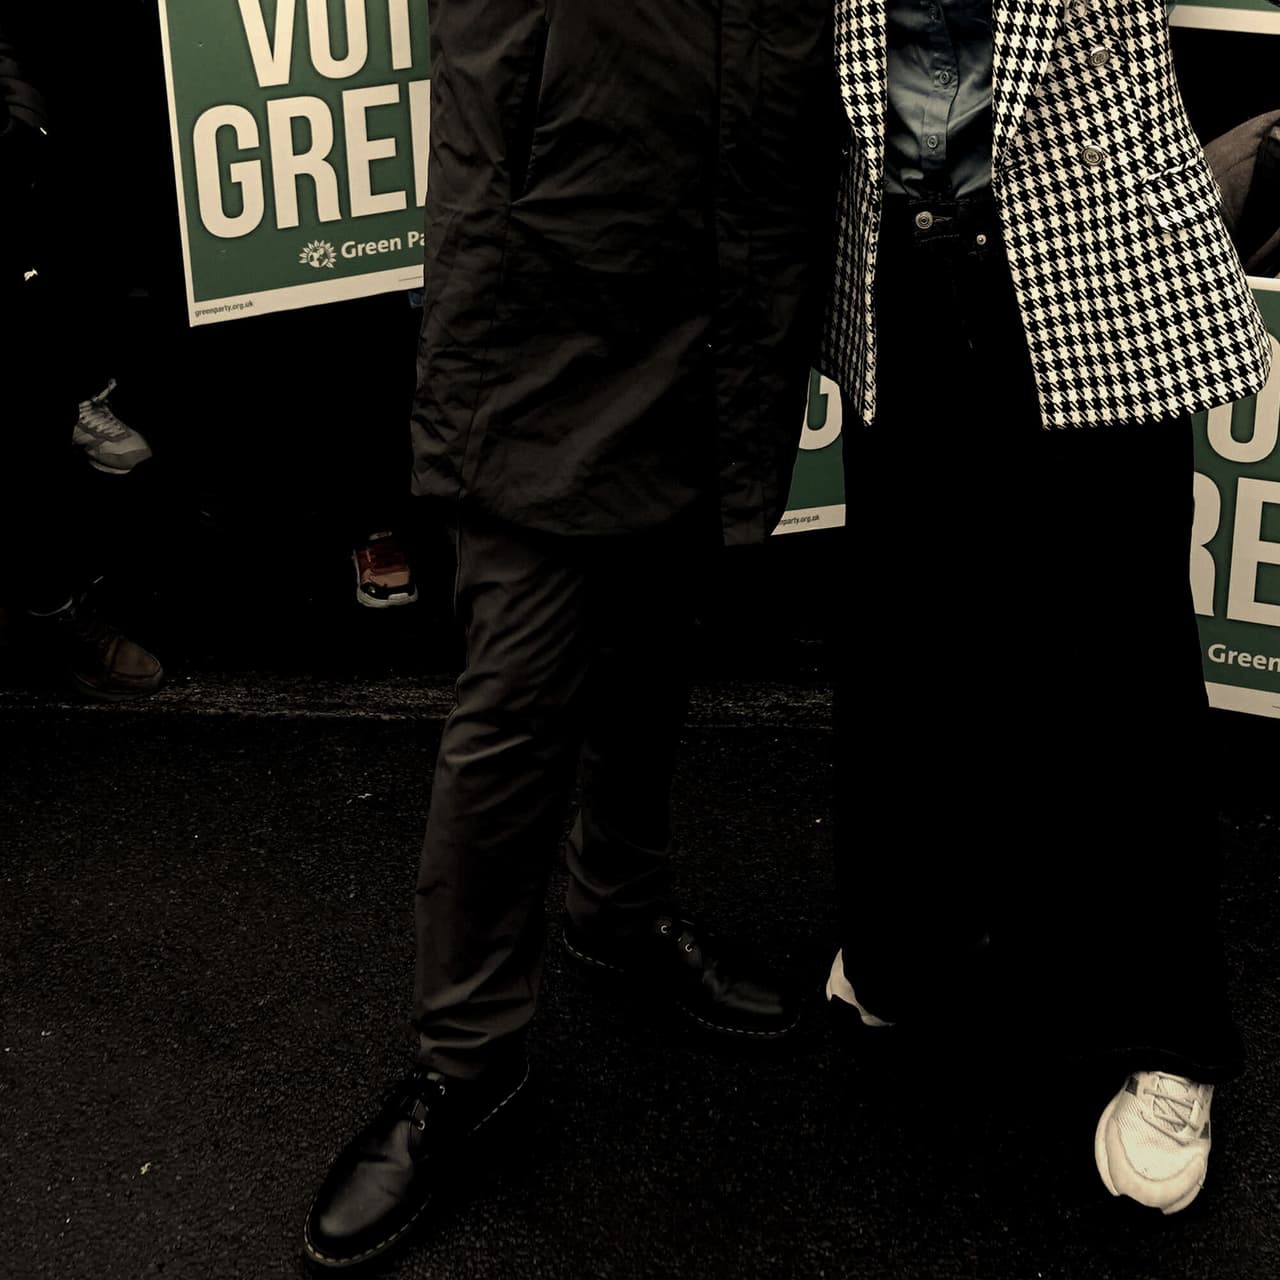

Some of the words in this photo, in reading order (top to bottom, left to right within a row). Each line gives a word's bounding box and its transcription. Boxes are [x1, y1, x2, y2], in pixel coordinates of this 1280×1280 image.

[193, 80, 430, 240] GRE
[341, 237, 402, 259] Green
[195, 300, 254, 318] greenparty.org.uk
